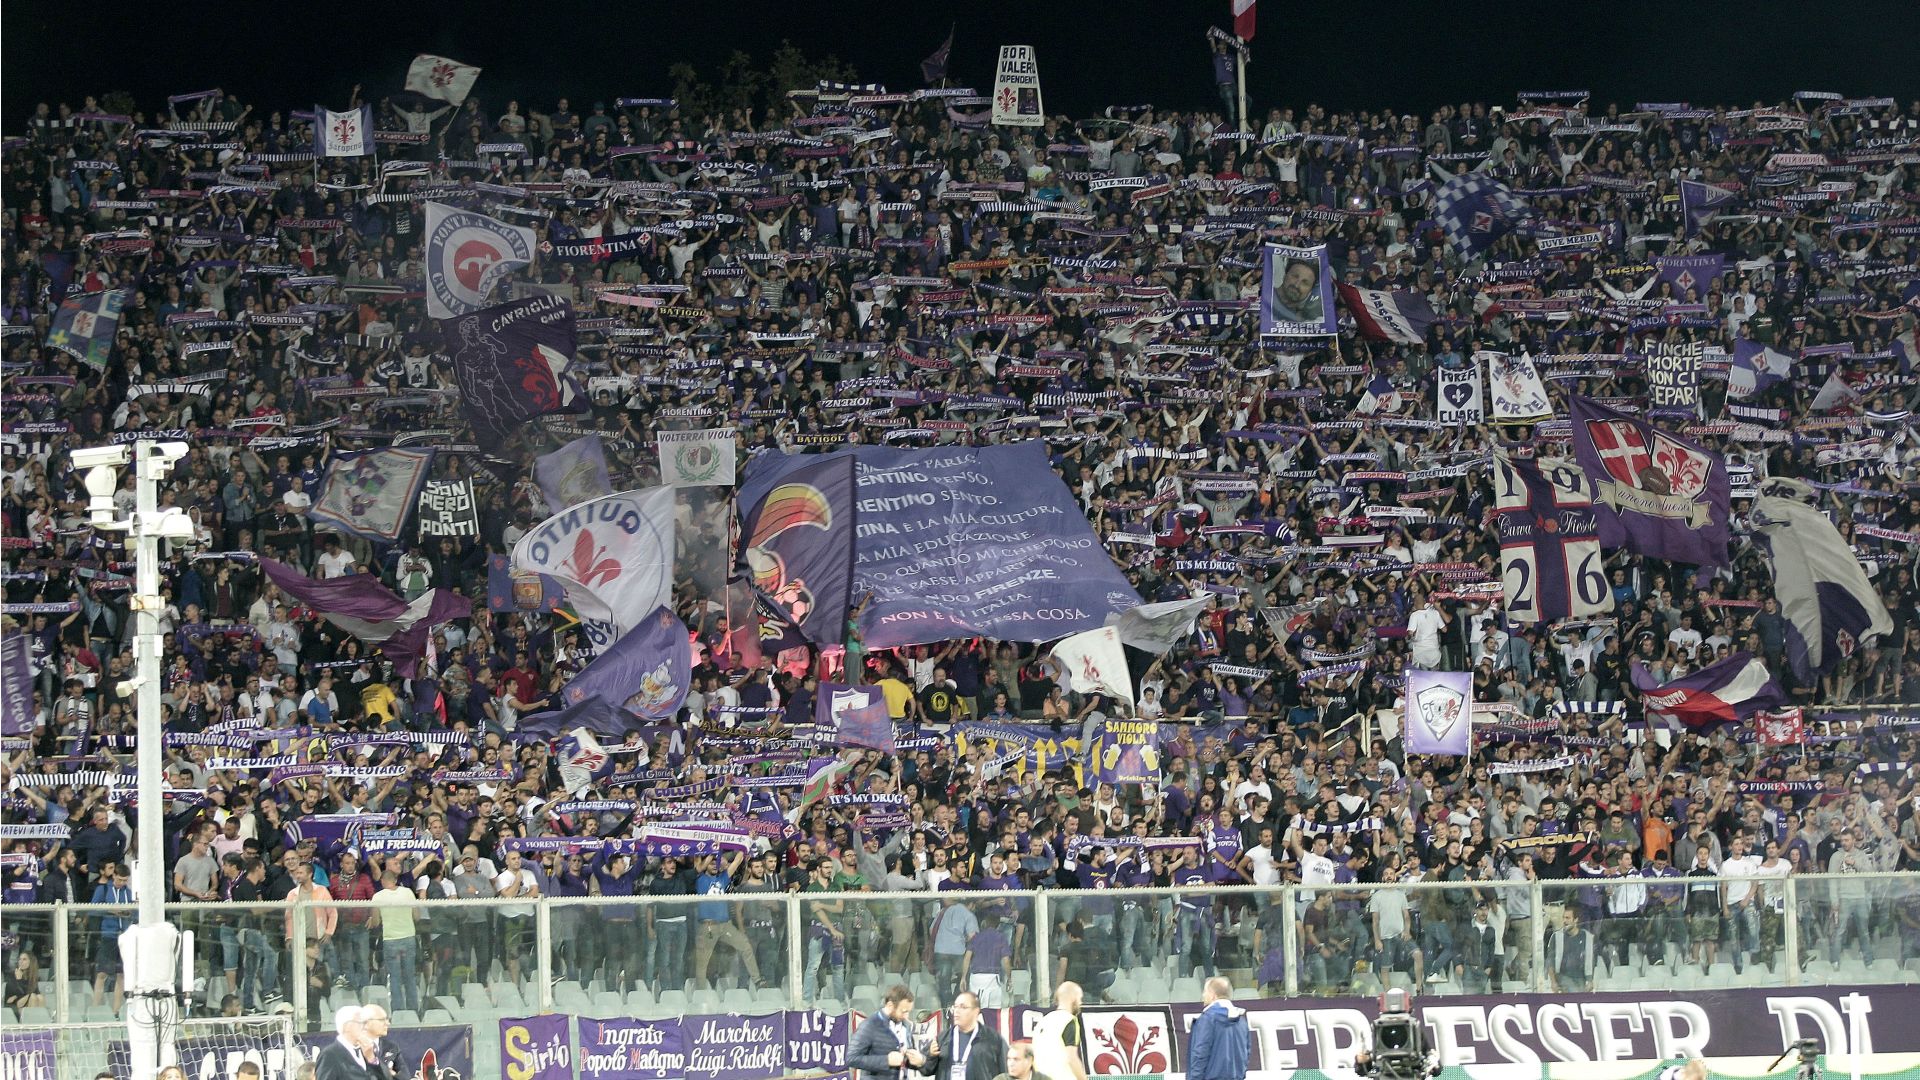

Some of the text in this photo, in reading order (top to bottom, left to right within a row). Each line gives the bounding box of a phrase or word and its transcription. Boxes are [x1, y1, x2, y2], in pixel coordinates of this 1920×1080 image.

[1212, 133, 1255, 141] COLLETTIVO
[212, 142, 238, 151] DRUG
[1092, 177, 1146, 190] JUVE MERDA
[433, 214, 470, 247] PONTE
[557, 240, 637, 257] FIORENTINA
[1540, 234, 1598, 249] JUVE MERDA
[1274, 249, 1319, 258] DAVIDE
[1052, 257, 1118, 269] FIORENZA
[1605, 264, 1655, 275] INCISA
[1658, 257, 1716, 268] FIORENTINA
[432, 271, 466, 316] CURVA
[491, 294, 566, 332] CAVRIGLIA
[660, 307, 706, 318] BATIGOL
[251, 316, 304, 325] FIORENTINA
[1319, 365, 1363, 374] FIORENTINA
[1648, 355, 1702, 371] MORTE
[1441, 370, 1478, 383] FORZA
[1648, 369, 1696, 385] NON CI
[983, 396, 1022, 406] FIORENTINA
[1495, 391, 1547, 415] PER TE!
[662, 407, 712, 416] FIORENTINA
[1316, 421, 1364, 429] COLLETTIVO
[113, 429, 190, 444] FIORENZA
[660, 430, 736, 443] VOLTERRA VIOLA
[797, 435, 845, 443] BATIGOL
[1416, 467, 1458, 478] COLLETTIVO
[1500, 460, 1581, 497] 1 9
[426, 480, 466, 496] SAN
[421, 492, 470, 512] PIERO
[440, 511, 453, 522] A
[917, 518, 940, 531] LA
[943, 512, 979, 525] MIA
[981, 505, 1064, 525] CULTURA
[421, 520, 476, 536] PONTI
[1498, 514, 1533, 537] Curva
[874, 531, 1035, 561] MIA EDUCAZIONE.
[895, 553, 971, 576] QUANDO
[976, 548, 998, 561] MI
[1001, 538, 1092, 557] CHIEDONO
[1176, 560, 1236, 571] IT'S MY DRUG
[974, 569, 1061, 600] FIRENZE.
[1505, 551, 1608, 611] 2 6
[971, 592, 1032, 617] ITALIA.
[881, 610, 928, 624] NON
[1036, 608, 1091, 620] COSA.
[1105, 721, 1158, 735] SAMMORO
[1759, 717, 1800, 728] 1 9
[166, 733, 225, 745] S.FREDIANO
[702, 737, 740, 747] Agosto
[1117, 733, 1146, 745] VIOLA
[1759, 733, 1800, 743] 9 5
[209, 756, 293, 768] S. FREDIANO
[326, 766, 406, 775] S. FREDIANO
[655, 776, 724, 797] COLLETTIVO
[1750, 782, 1812, 791] FIORENTINA
[829, 794, 903, 805] IT'S MY DRUG
[560, 802, 630, 812] ACF FIORENTINA
[29, 825, 37, 836] A
[693, 832, 735, 842] FIORENTINA
[365, 840, 440, 850] SAN FREDIANO
[1505, 832, 1584, 849] VERONA
[800, 1010, 836, 1037] ACF
[1765, 992, 1875, 1056] DI
[597, 1022, 665, 1053] Ingrato
[694, 1019, 773, 1045] Marchese
[1422, 1001, 1711, 1066] ESSER
[505, 1025, 570, 1080] Spirito
[789, 1040, 846, 1067] YOUTH
[580, 1047, 685, 1078] Popolo Maligno
[684, 1045, 784, 1079] Luigi Ridolfi
